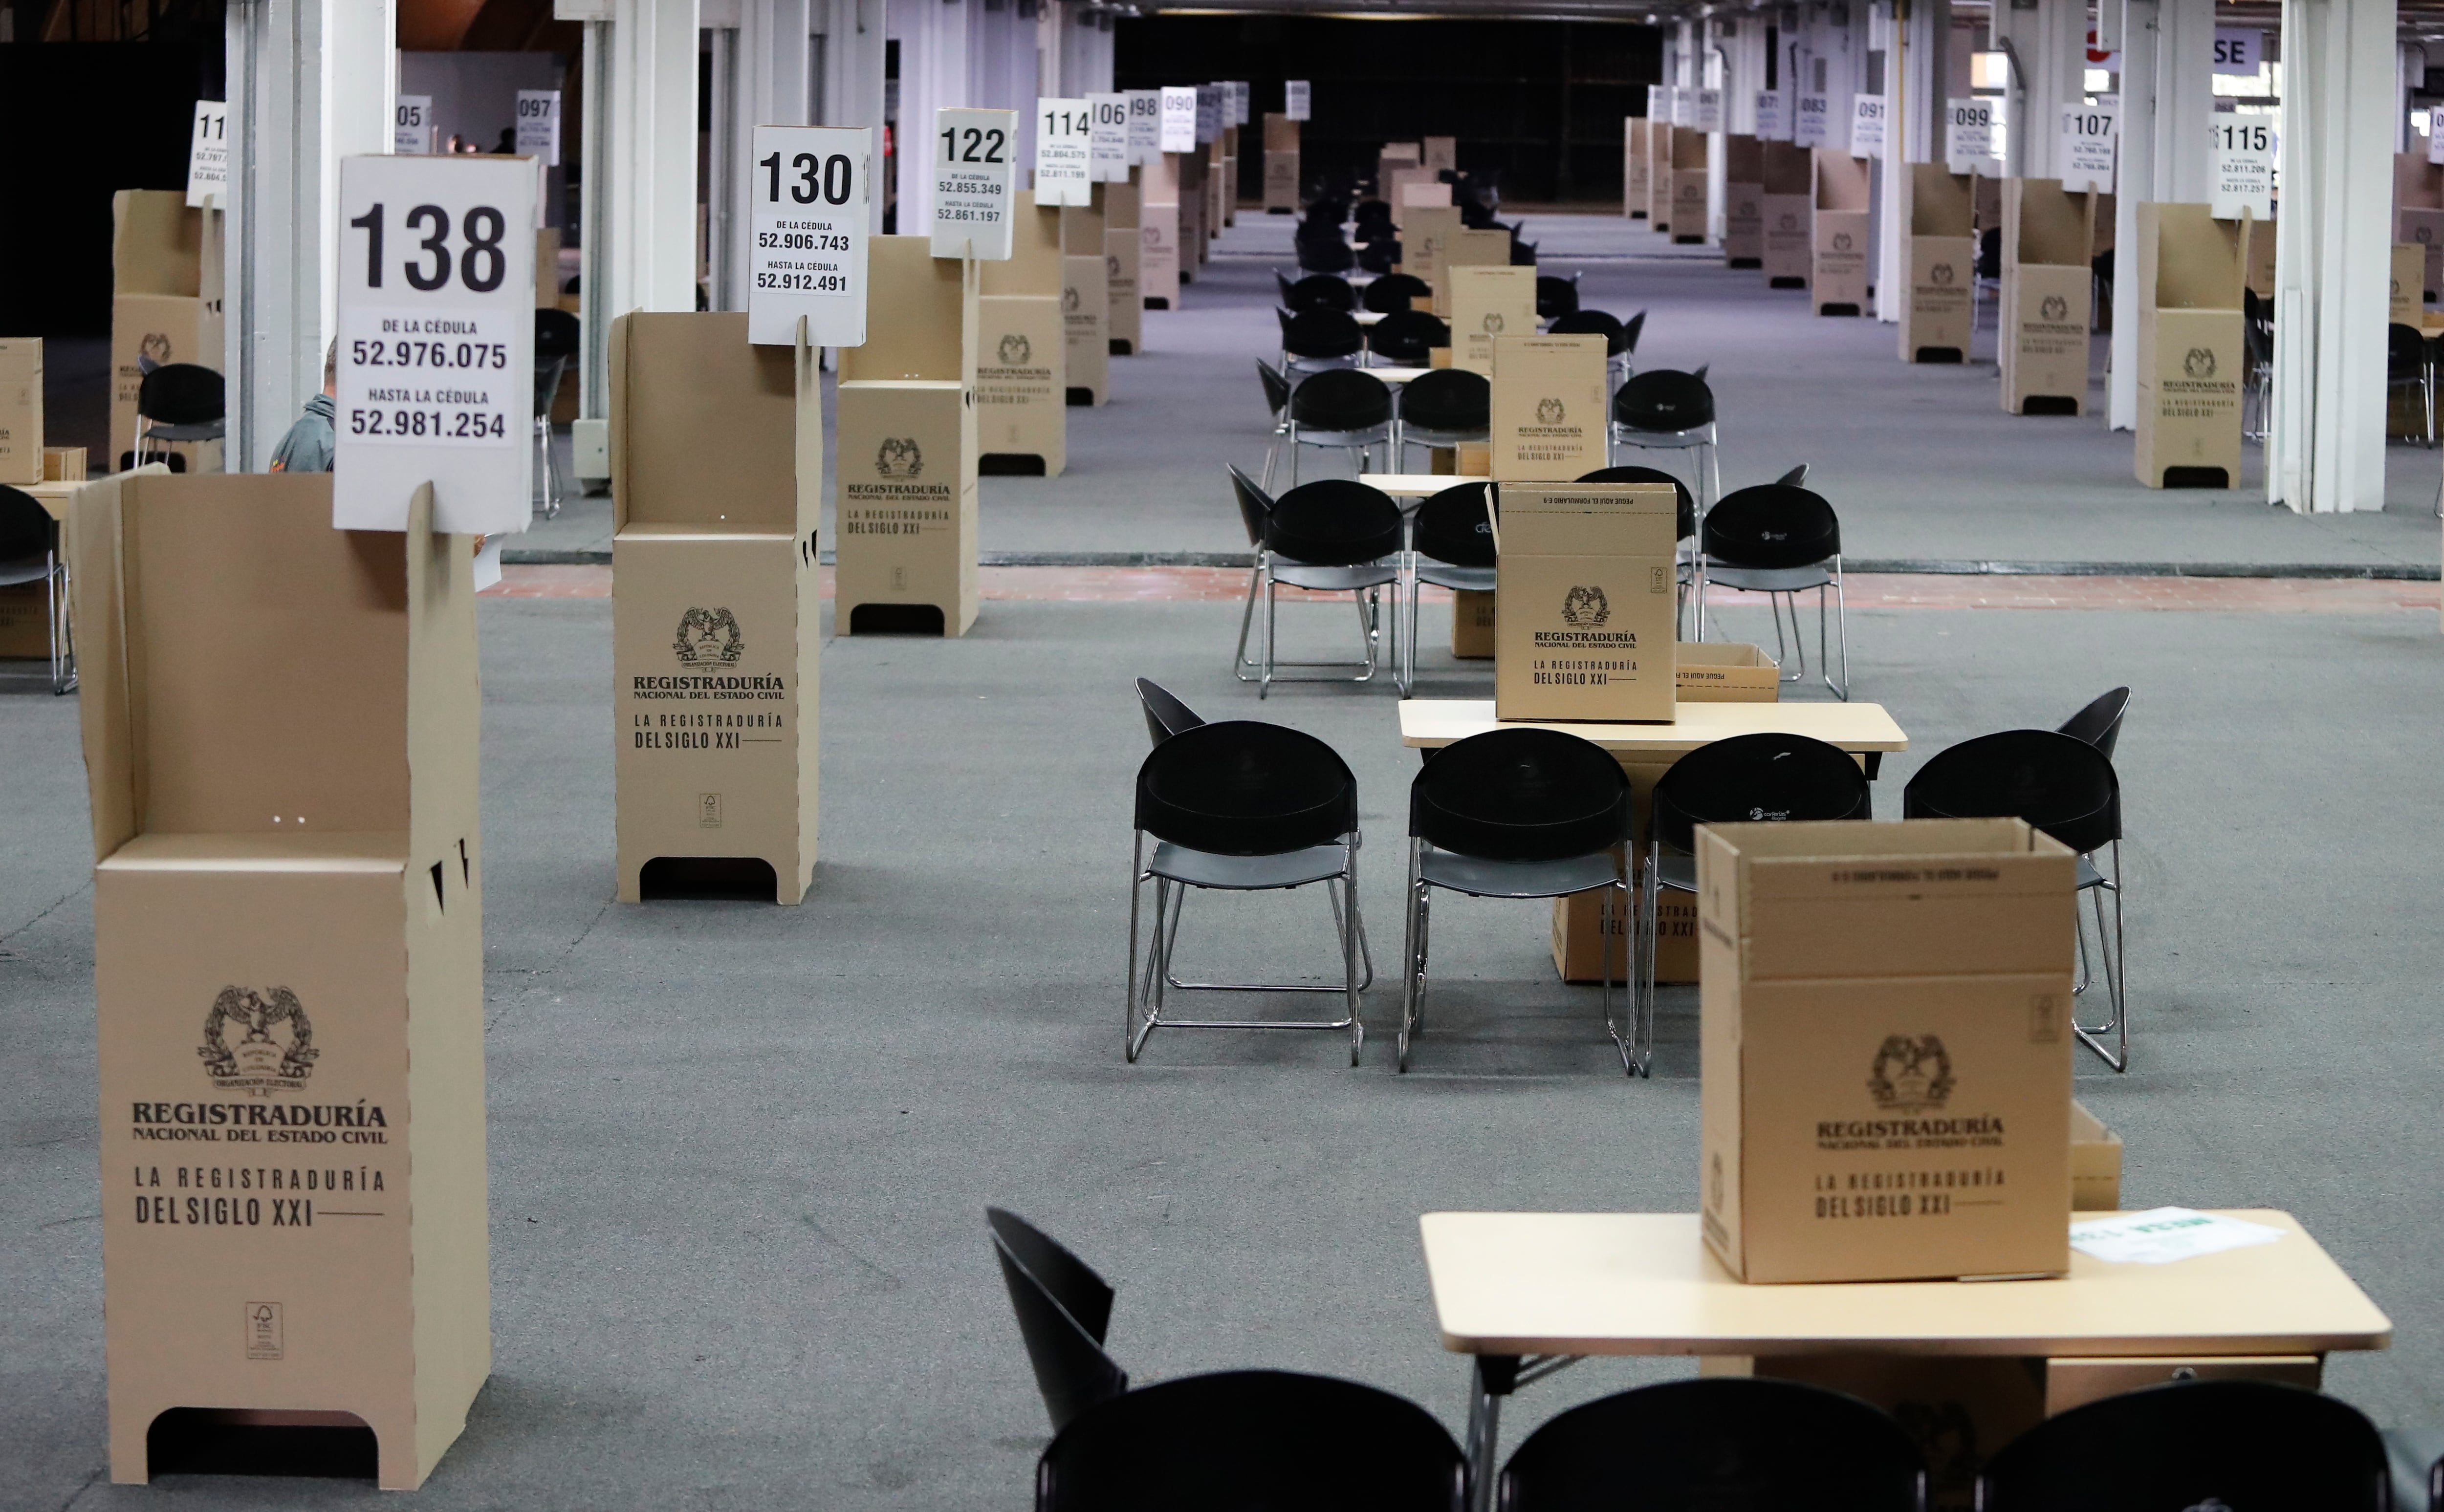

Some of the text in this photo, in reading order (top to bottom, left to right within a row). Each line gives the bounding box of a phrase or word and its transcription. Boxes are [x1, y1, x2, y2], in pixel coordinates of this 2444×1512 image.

[520, 99, 551, 117] 097
[1165, 95, 1193, 110] 090
[1859, 102, 1884, 119] 091
[398, 106, 420, 127] 05
[1045, 110, 1090, 136] 114
[1957, 108, 1988, 126] 099
[2074, 114, 2112, 136] 107
[200, 113, 226, 140] 11
[941, 127, 1005, 164] 122
[2223, 125, 2267, 151] 115
[196, 152, 228, 162] 52.797.
[194, 171, 227, 182] 52.804.5
[760, 151, 852, 205] 130
[939, 181, 1002, 195] 52.855.349
[938, 209, 1000, 222] 52.861.197
[776, 220, 832, 231] DE LA CÉDULA
[351, 202, 506, 293] 138
[759, 232, 850, 251] 52.906.743
[767, 260, 838, 272] HASTA LA CÉDULA
[758, 273, 847, 291] 52.912.491
[382, 317, 478, 335] DE LA CÉDULA
[352, 340, 507, 369] 52.976.075
[369, 386, 489, 405] HASTA LA CÉDULA
[350, 410, 505, 438] 52.981.254
[848, 482, 950, 495] REGISTRADURÍA
[848, 509, 949, 519] LA REGISTRADURÍA
[848, 522, 920, 534] DEL SIGLO XXI
[1534, 630, 1637, 642] REGISTRADURÍA
[1534, 660, 1637, 670] LA REGISTRADURÍA
[633, 672, 784, 690] REGISTRADURÍA
[1534, 673, 1607, 685] DEL SIGLO XXI
[633, 691, 785, 700] NACIONAL DEL ESTADO CIVIL
[635, 713, 782, 727] LA REGISTRADURÍA
[635, 732, 740, 749] DEL SIGLO XXI
[1673, 922, 1693, 937] XXI
[132, 1099, 388, 1128] REGISTRADURÍA
[1816, 1114, 2004, 1138] REGISTRADURÍA
[133, 1127, 389, 1145] NACIONAL DEL ESTADO CIVIL
[135, 1166, 385, 1191] LA REGISTRADURÍA
[135, 1197, 313, 1227] DEL SIGLO XXI
[1815, 1193, 1950, 1218] DEL SIGLO XXI
